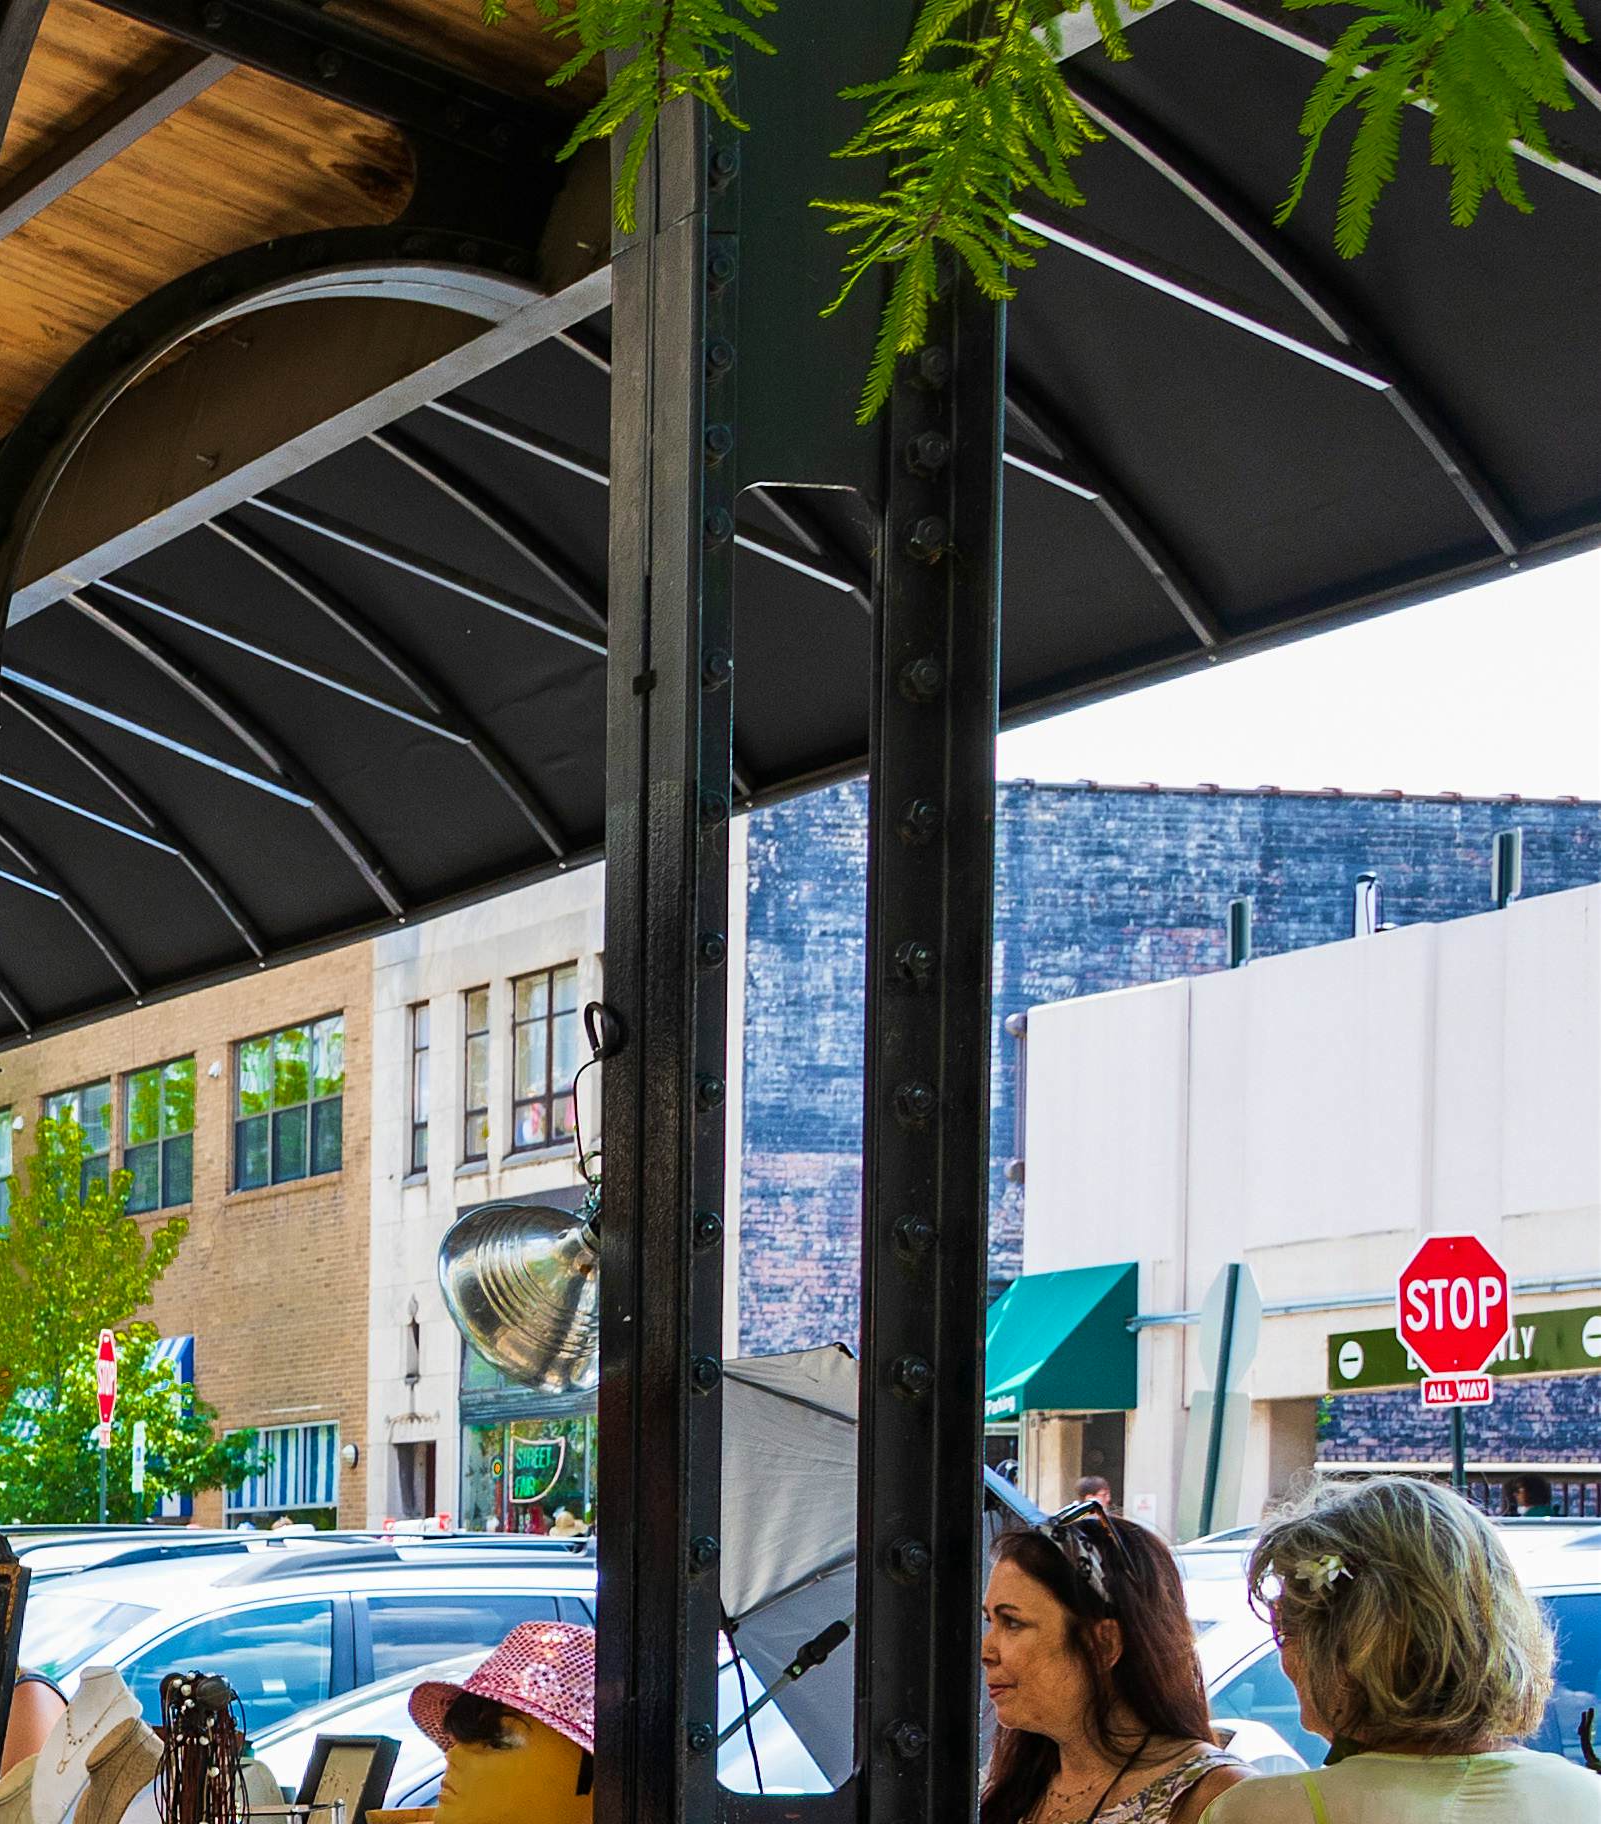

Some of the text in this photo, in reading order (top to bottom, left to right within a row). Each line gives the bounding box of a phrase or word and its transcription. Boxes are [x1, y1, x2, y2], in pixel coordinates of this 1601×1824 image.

[1405, 1276, 1502, 1332] STOP
[1427, 1380, 1488, 1401] ALL WAY
[516, 1446, 553, 1470] STREET
